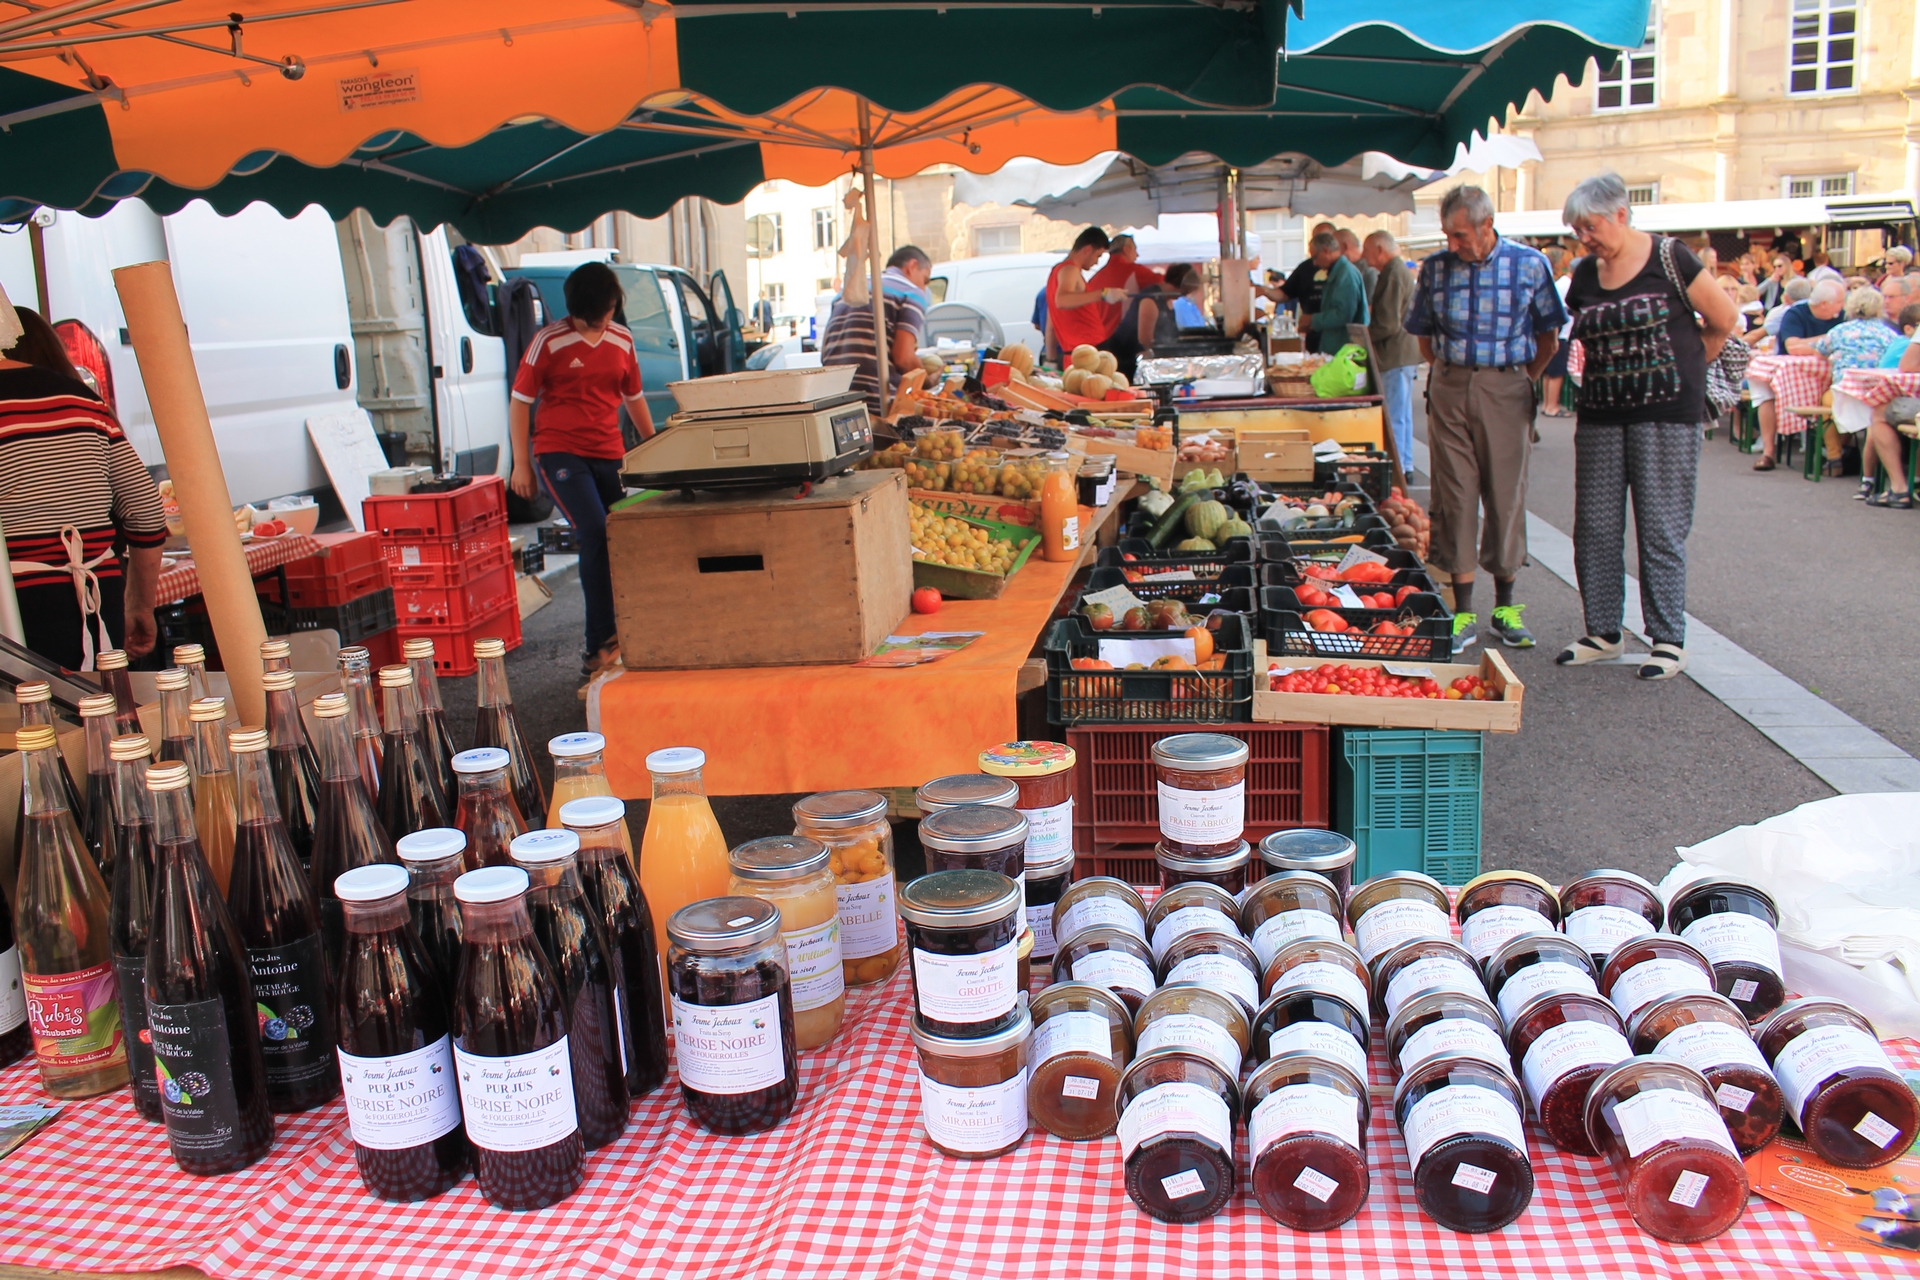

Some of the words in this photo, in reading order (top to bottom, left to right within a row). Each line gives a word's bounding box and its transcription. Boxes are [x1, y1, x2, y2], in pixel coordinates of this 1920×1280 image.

[340, 77, 368, 85] PARASOLS
[342, 77, 412, 93] wongleon
[1169, 815, 1197, 827] FRAISE
[1200, 816, 1234, 827] ABRICOT
[1030, 832, 1059, 842] POMME
[846, 893, 870, 904] Jechoux
[839, 910, 882, 926] ABELLE
[1365, 923, 1392, 942] REINE
[1395, 919, 1439, 932] CLAUDE
[1469, 928, 1497, 944] FRUITS
[798, 936, 824, 950] Jechoux
[1699, 936, 1750, 948] MYRTILLE
[797, 947, 833, 963] Williams
[800, 965, 816, 974] sirop
[956, 969, 978, 977] Ferme
[979, 962, 1004, 977] Jechoux
[272, 984, 300, 996] ROUGE
[959, 980, 1003, 996] GRIOTTE
[1633, 976, 1666, 991] COING
[29, 1000, 82, 1029] Rubis
[691, 1014, 712, 1026] Ferme
[712, 1016, 742, 1029] Jechoux
[42, 1027, 82, 1036] rhubarbe
[677, 1031, 717, 1051] CERISE
[720, 1032, 767, 1050] NOIRE
[1157, 1035, 1219, 1051] ANTILLAISE
[1432, 1038, 1493, 1050] GROSEILLE
[696, 1050, 749, 1060] FOUGEROLLES
[1539, 1038, 1600, 1069] FRAMBOISE
[1680, 1044, 1708, 1060] MARIE
[1795, 1043, 1853, 1074] QUETSCHE
[363, 1070, 386, 1080] Ferme
[386, 1065, 419, 1081] Jechoux
[480, 1068, 504, 1080] Ferme
[504, 1066, 538, 1082] Jechoux
[368, 1083, 391, 1094] PUR
[393, 1080, 415, 1093] JUS
[486, 1083, 509, 1094] PUR
[511, 1081, 534, 1093] JUS
[350, 1095, 394, 1113] CERISE
[400, 1084, 445, 1110] NOIRE
[466, 1093, 513, 1113] CERISE
[517, 1087, 563, 1111] NOIRE
[946, 1099, 967, 1109] Ferme
[967, 1099, 997, 1110] Jechoux
[372, 1105, 430, 1121] FOUGEROLLES
[489, 1109, 547, 1122] FOUGEROLLES
[1138, 1104, 1188, 1121] GRIOTTE
[1280, 1106, 1336, 1122] SAUVAGE
[1417, 1108, 1453, 1133] CERISE
[1462, 1106, 1500, 1117] NOIRE
[941, 1115, 1003, 1126] MIRABELLE
[1791, 1167, 1831, 1181] Ouvert
